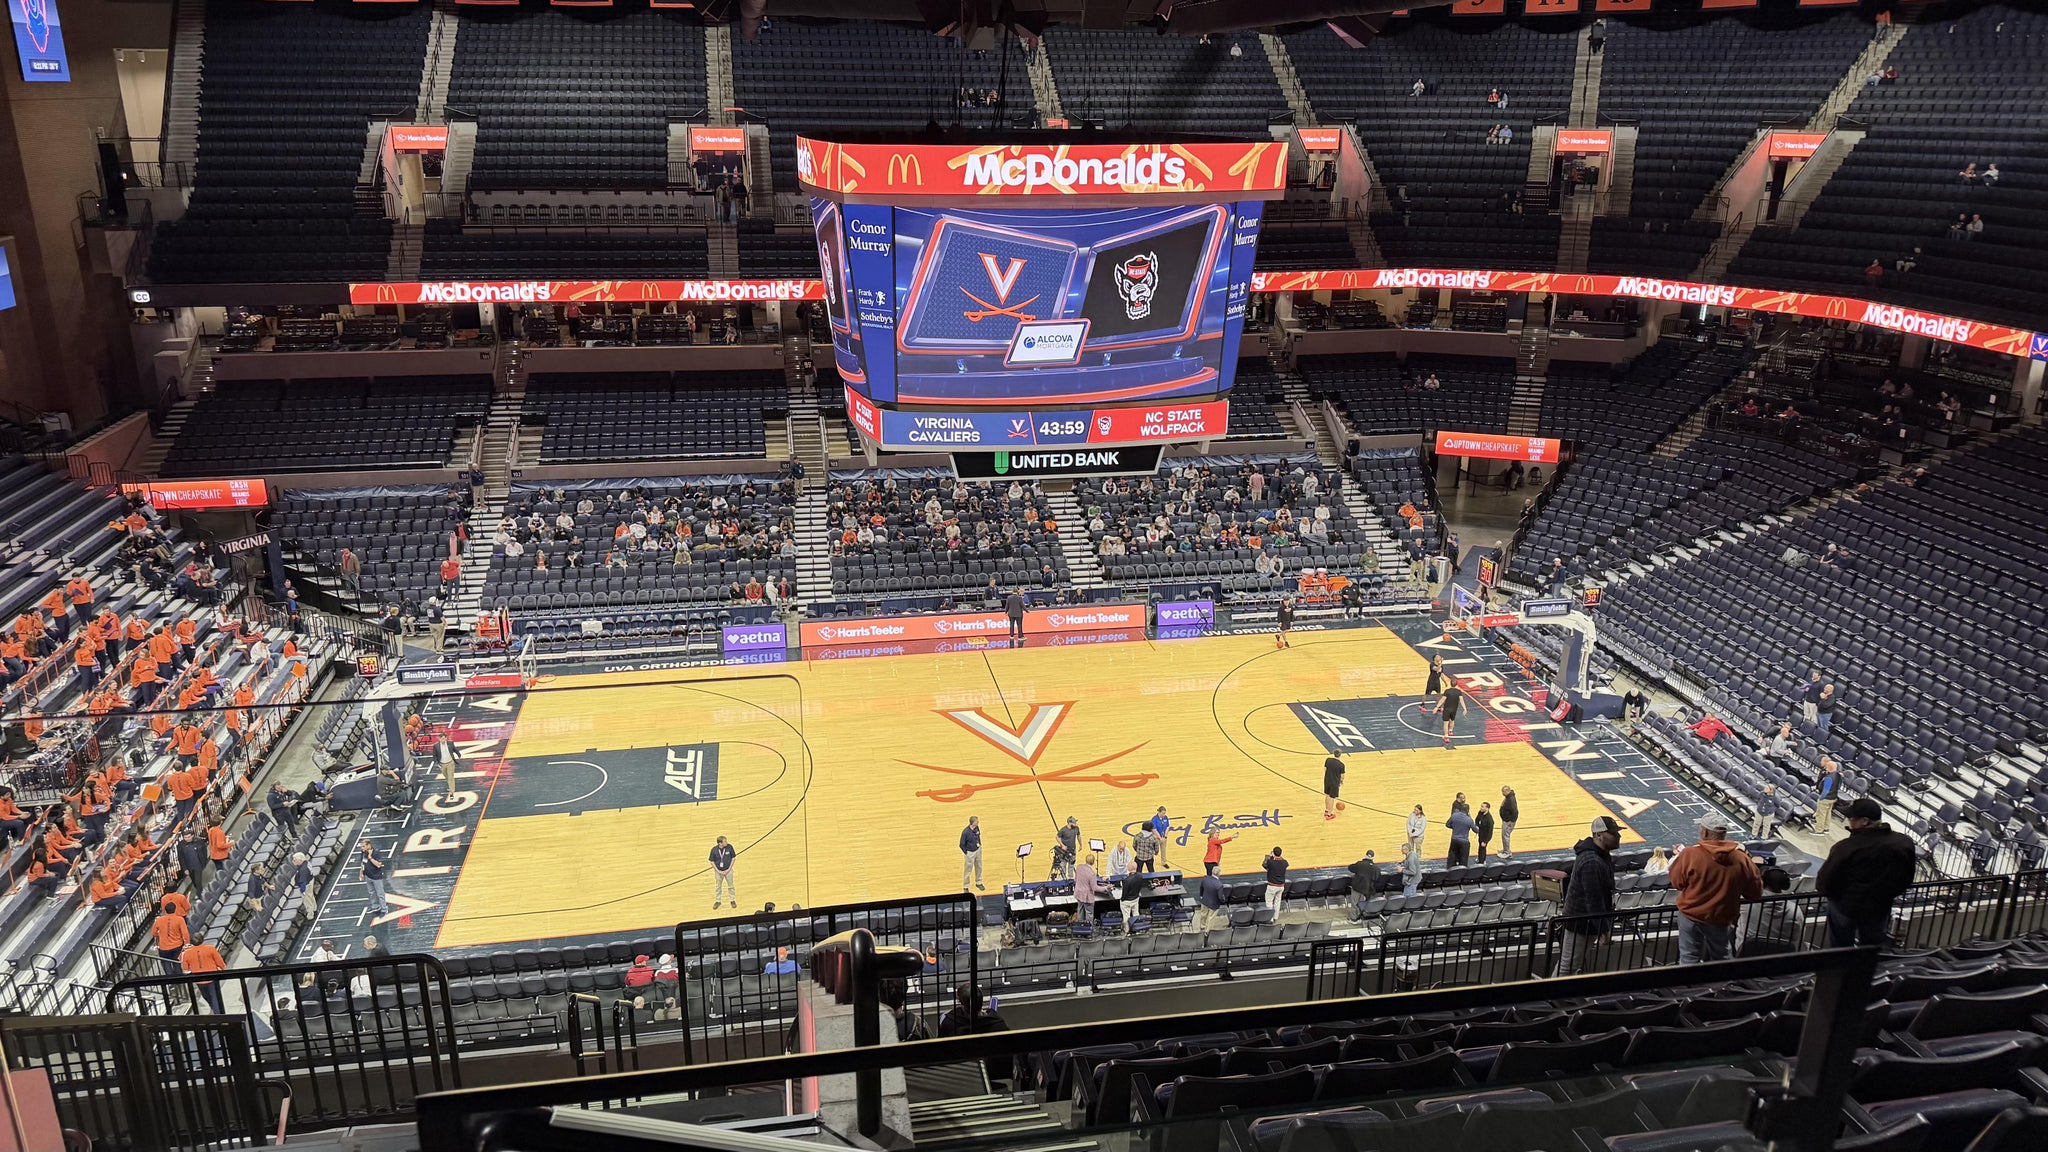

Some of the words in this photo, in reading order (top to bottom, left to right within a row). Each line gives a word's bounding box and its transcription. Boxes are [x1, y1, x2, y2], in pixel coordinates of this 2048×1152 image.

[963, 152, 1186, 186] McDonald's
[851, 220, 887, 234] Conor
[1238, 216, 1258, 229] Conor
[850, 236, 891, 256] Murray
[1234, 233, 1258, 247] Murray
[1376, 270, 1490, 288] McDonald's
[420, 284, 550, 300] McDonald's
[682, 282, 804, 299] McDonald's
[1616, 278, 1734, 305] McDonald's
[859, 298, 874, 306] Hardy
[860, 312, 893, 324] Sotheby's
[1863, 304, 1969, 341] McDonald's
[1037, 335, 1073, 343] ALCOVA
[914, 417, 973, 429] VIRGINIA
[1146, 412, 1164, 423] NC
[1167, 409, 1202, 421] STATE
[1039, 421, 1085, 435] 43:59
[1140, 422, 1205, 436] WOLFPACK
[908, 430, 980, 442] CAVALIERS
[1454, 440, 1480, 450] UPTOWN
[1481, 441, 1519, 452] CHEAPSKATE
[1012, 454, 1074, 469] UNITED
[1076, 452, 1119, 466] BANK
[178, 489, 221, 500] CHEAPSKATE
[220, 534, 271, 554] VIRGINIA
[953, 621, 985, 630] Harris
[1066, 614, 1097, 624] Harris
[1097, 613, 1129, 622] Teeter
[741, 632, 780, 644] aetna
[838, 627, 870, 637] Harris
[870, 625, 904, 635] Teeter
[604, 665, 634, 673] UVA
[639, 658, 744, 669] ORTHOPEDICS
[404, 670, 449, 680] Smithfield
[1311, 707, 1376, 748] ACC
[664, 748, 696, 795] ACC
